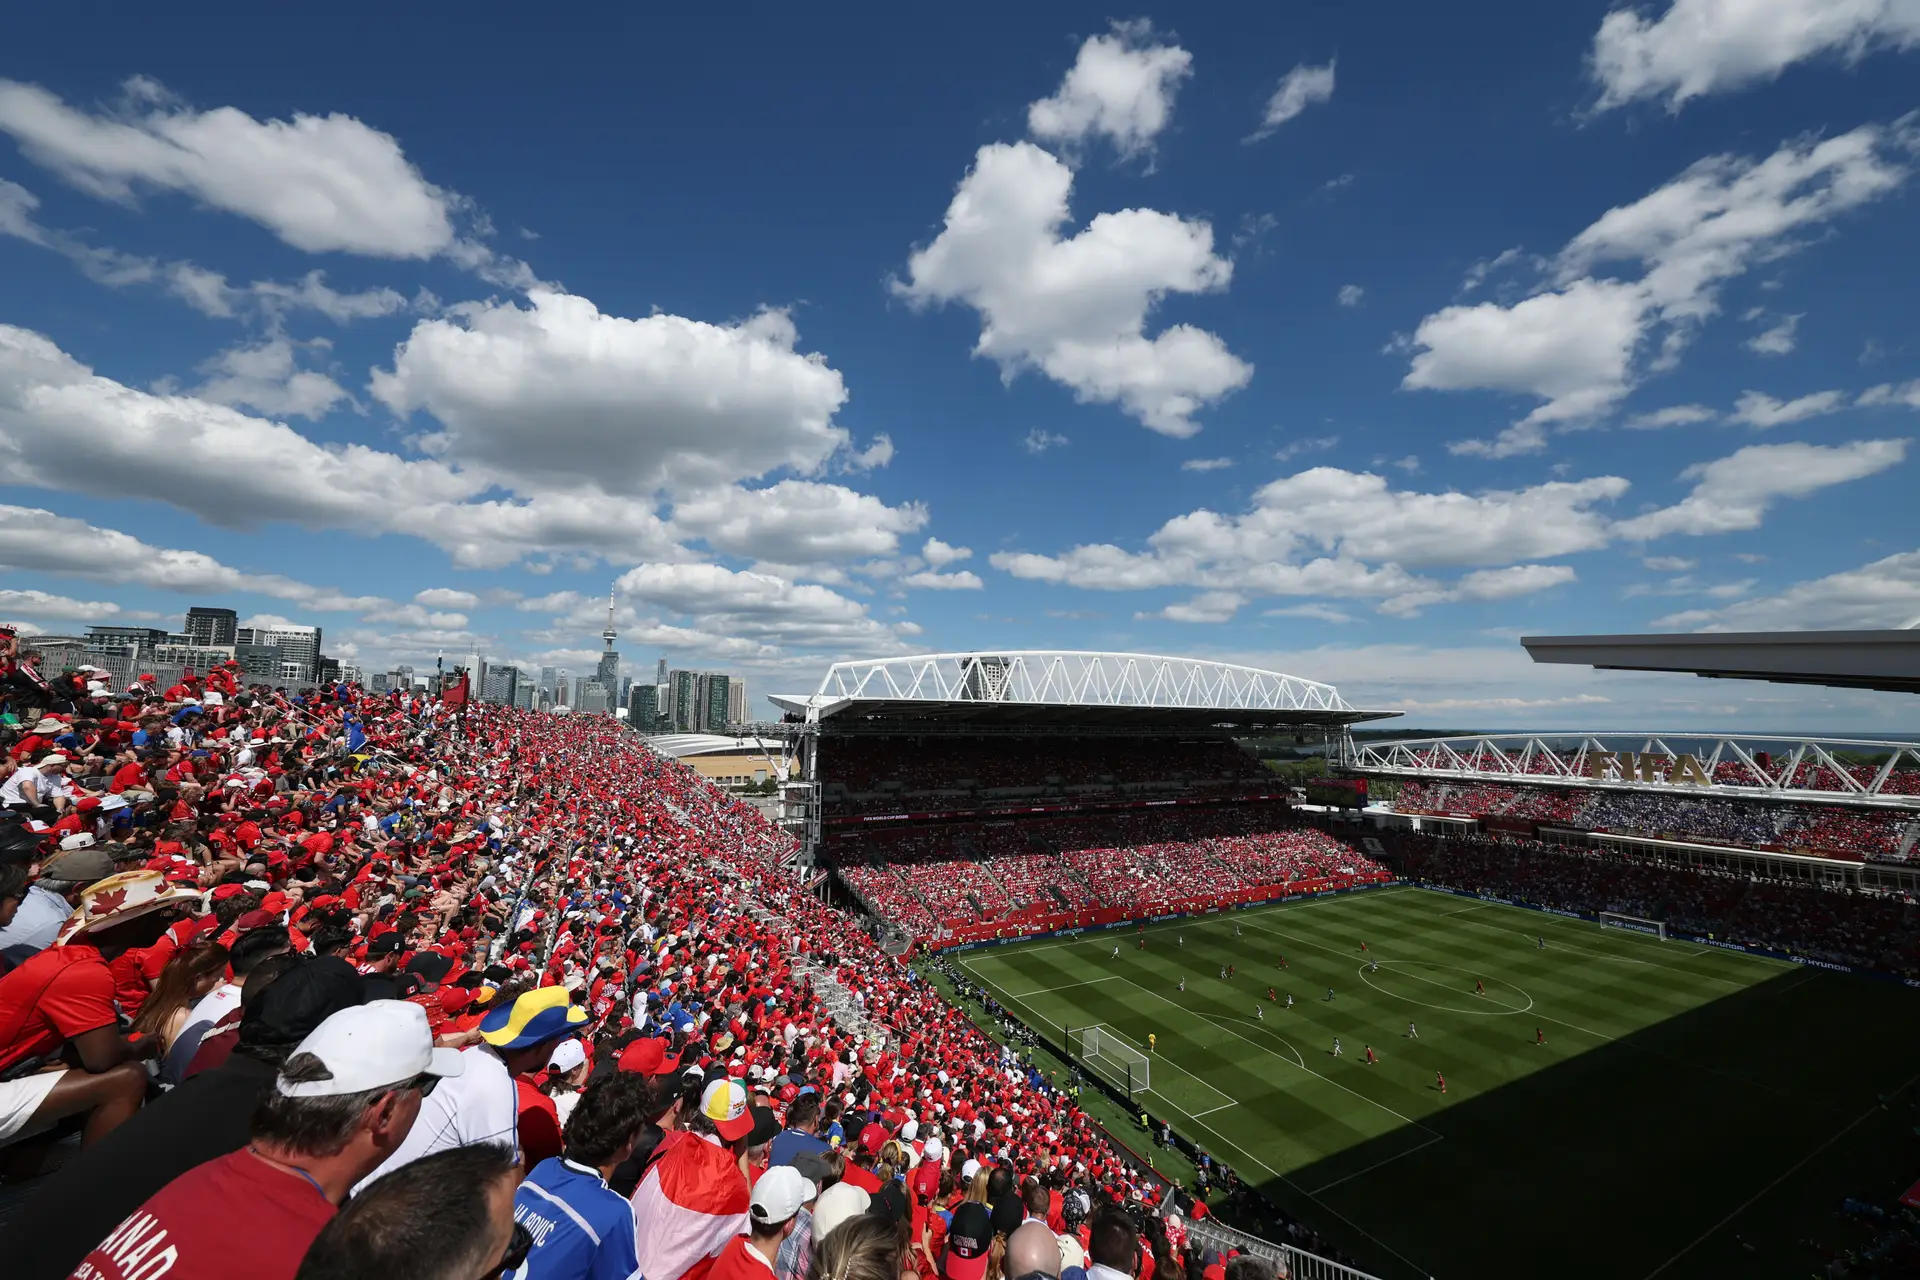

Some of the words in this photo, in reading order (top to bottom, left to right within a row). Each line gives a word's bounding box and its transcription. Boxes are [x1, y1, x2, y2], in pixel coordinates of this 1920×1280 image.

[1590, 751, 1712, 786] FIFA
[1488, 897, 1513, 905] HYUNDAI
[1552, 908, 1580, 918] HYUNDAI
[1624, 923, 1656, 934] HYUNDAI
[950, 944, 974, 952] HYUNDAI
[1708, 940, 1745, 952] HYUNDAI
[1808, 959, 1851, 973] HYUNDAI
